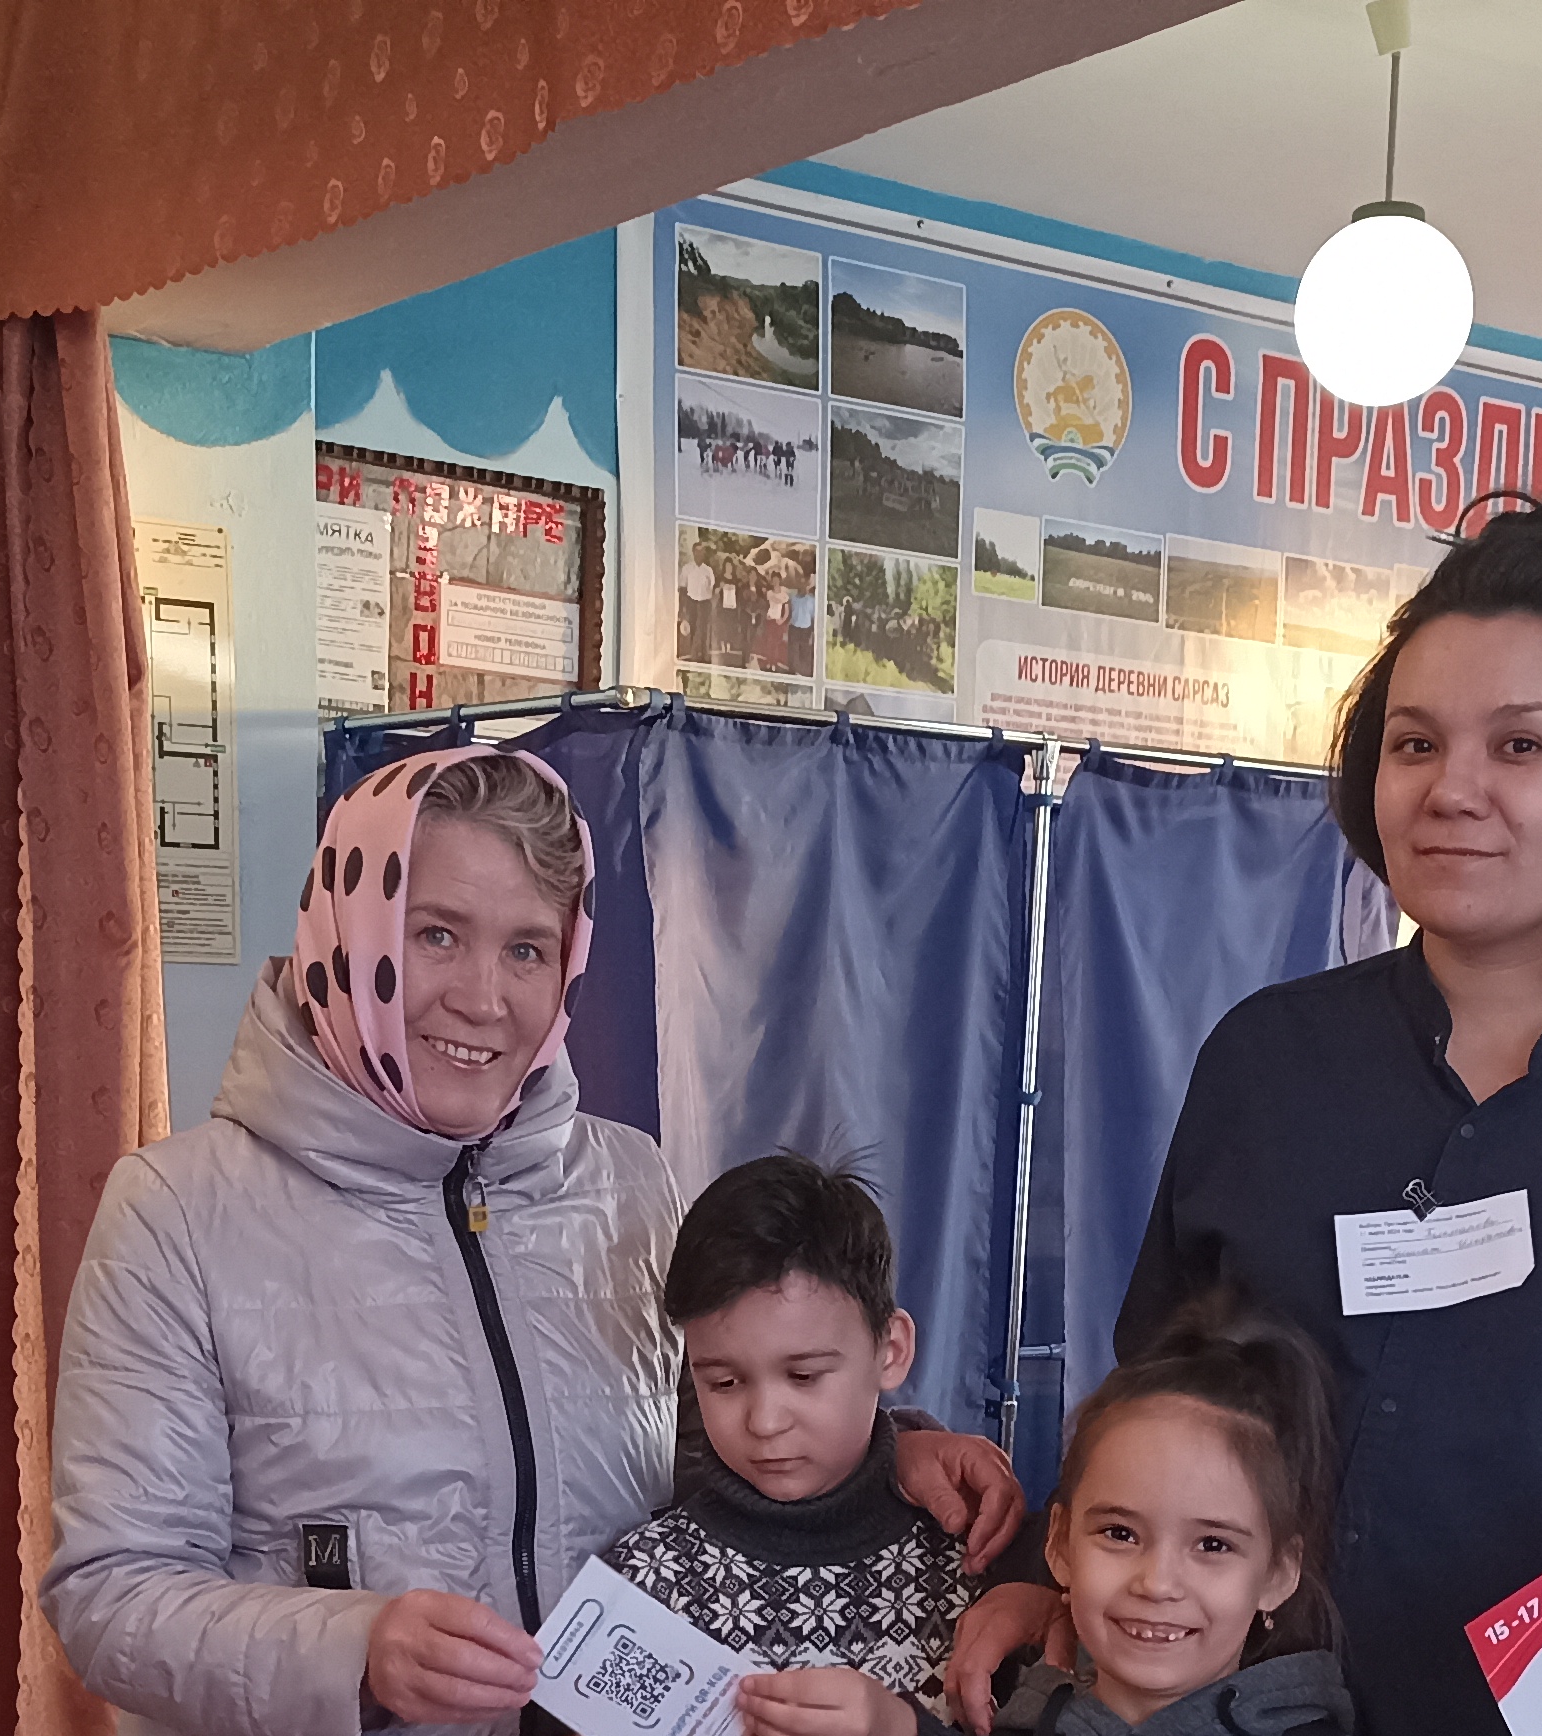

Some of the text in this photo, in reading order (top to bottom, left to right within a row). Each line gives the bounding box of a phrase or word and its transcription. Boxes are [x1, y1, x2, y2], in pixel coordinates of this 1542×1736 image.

[1178, 334, 1235, 492] С
[392, 477, 565, 544] ПОЖАРЕ
[1017, 655, 1230, 709] ИСТОРИЯ ДЕРЕВНИ САРСАЗ
[308, 1534, 340, 1566] M
